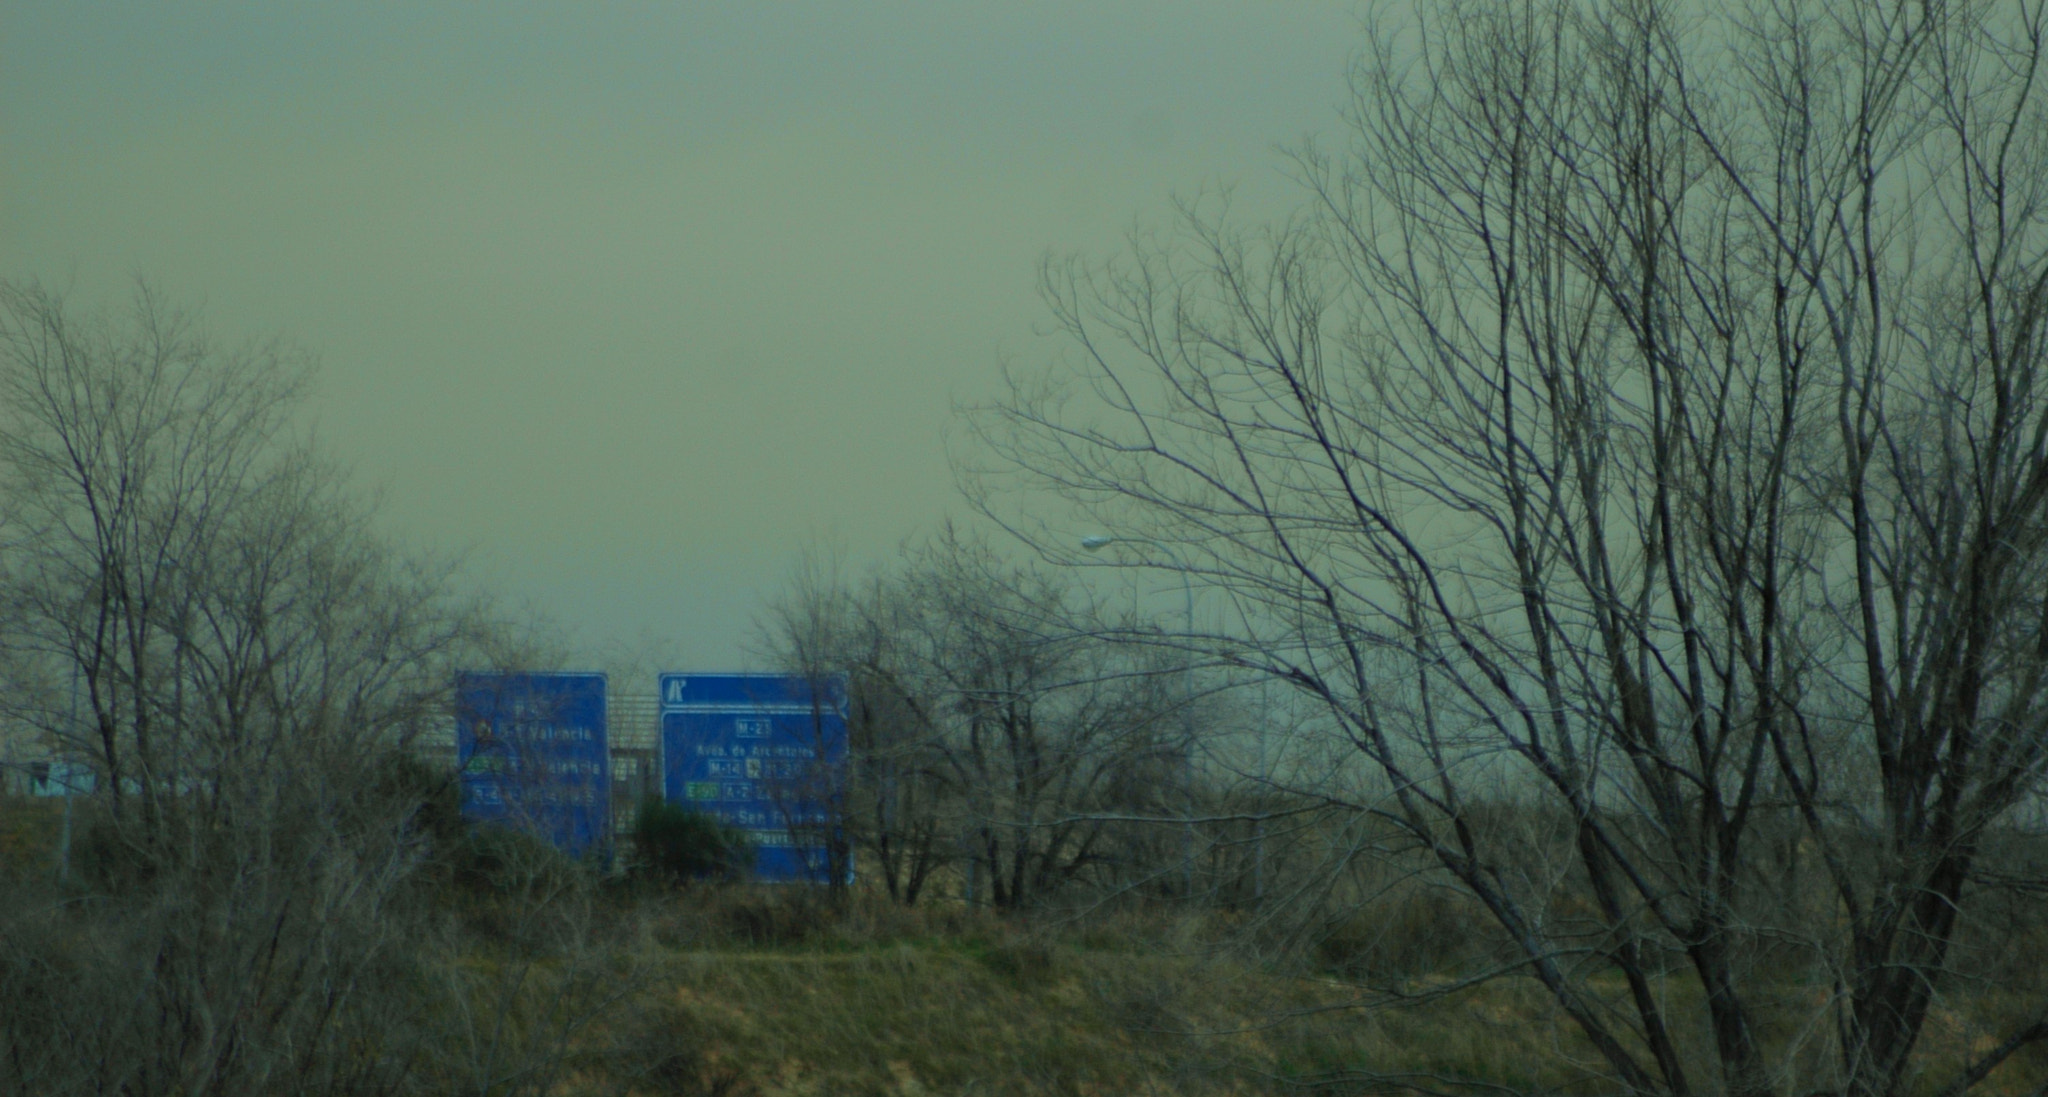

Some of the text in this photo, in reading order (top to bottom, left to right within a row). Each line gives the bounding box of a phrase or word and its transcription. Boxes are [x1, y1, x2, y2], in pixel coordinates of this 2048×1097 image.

[529, 727, 592, 741] Valencia
[732, 745, 745, 757] de
[541, 761, 600, 775] alencia
